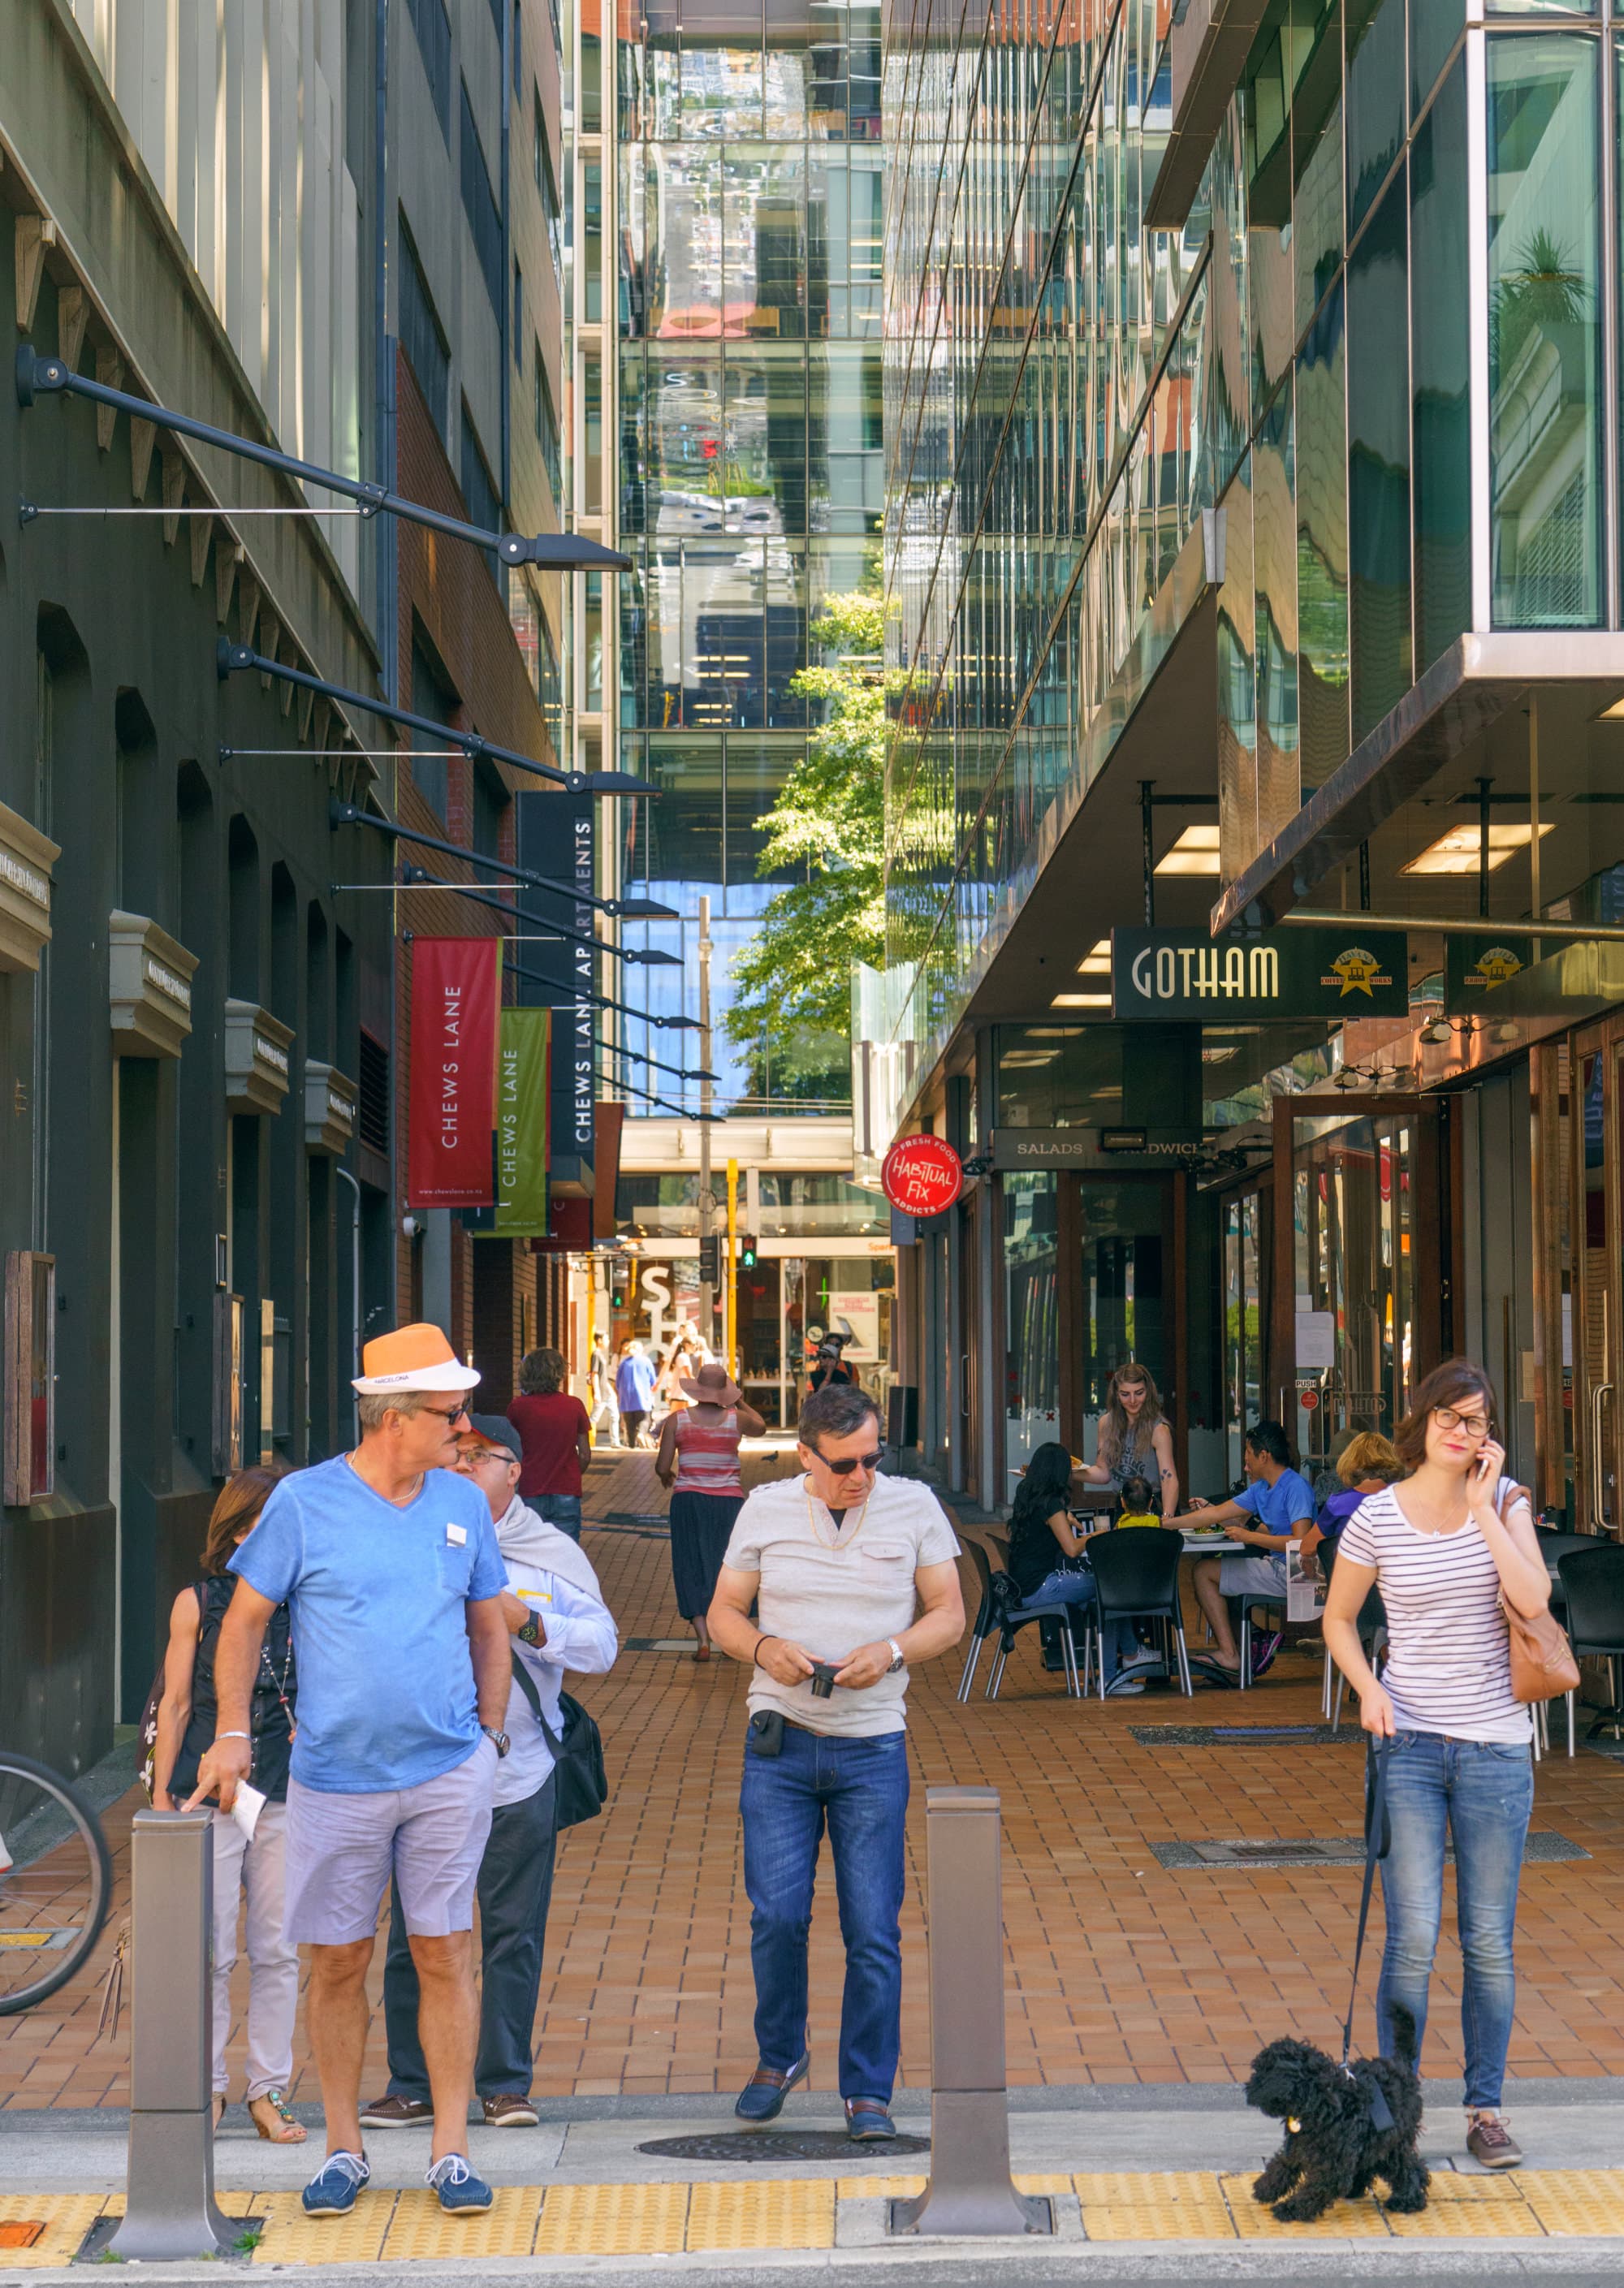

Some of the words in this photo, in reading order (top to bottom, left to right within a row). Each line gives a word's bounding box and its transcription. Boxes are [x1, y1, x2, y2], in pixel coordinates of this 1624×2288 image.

[1131, 947, 1279, 999] GOTHAM
[443, 986, 461, 1047] LANE
[503, 1050, 518, 1102] LANE
[575, 1061, 592, 1143] CHEWS
[442, 1062, 459, 1148] CHEWS
[502, 1114, 517, 1187] CHEWS
[900, 1138, 931, 1150] FRESH
[935, 1141, 957, 1163] FOOD
[1017, 1143, 1083, 1155] SALADS
[893, 1197, 936, 1214] ADDICTS
